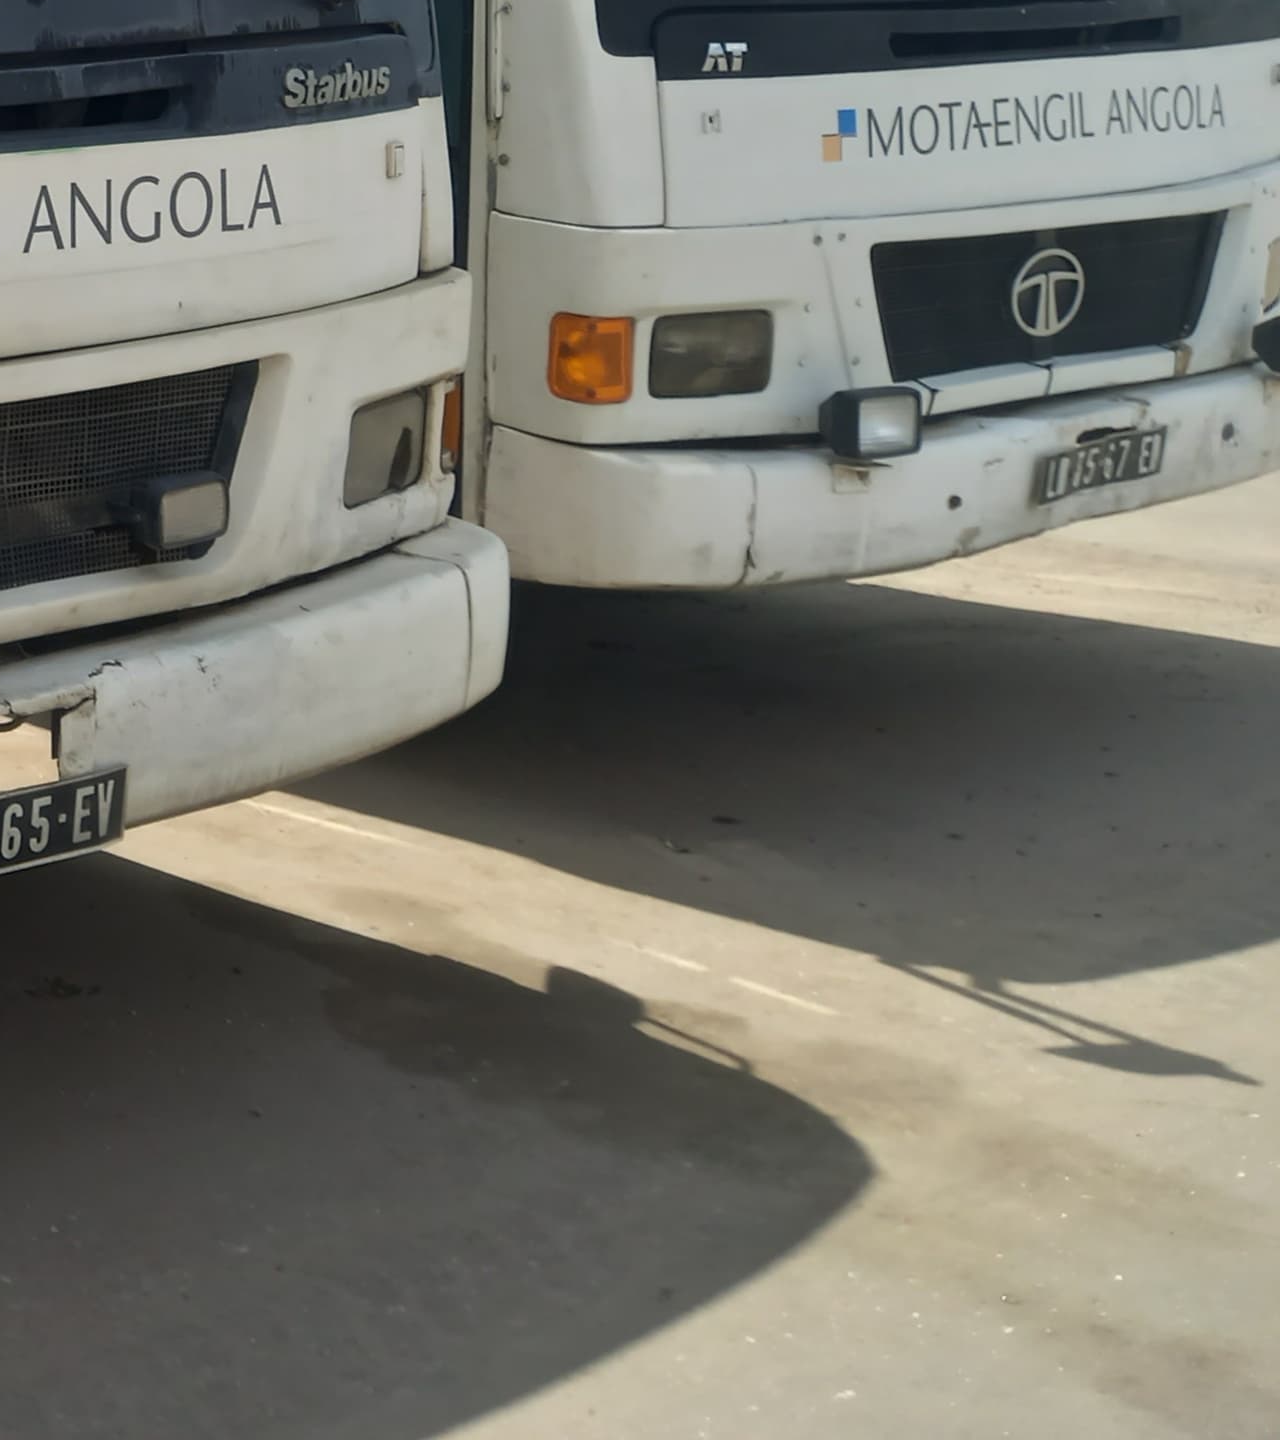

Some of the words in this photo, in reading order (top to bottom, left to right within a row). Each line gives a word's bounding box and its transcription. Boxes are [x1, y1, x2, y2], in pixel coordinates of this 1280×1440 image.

[284, 61, 391, 108] Starbus
[1105, 84, 1225, 136] ANGOLA
[23, 163, 282, 255] ANGOLA
